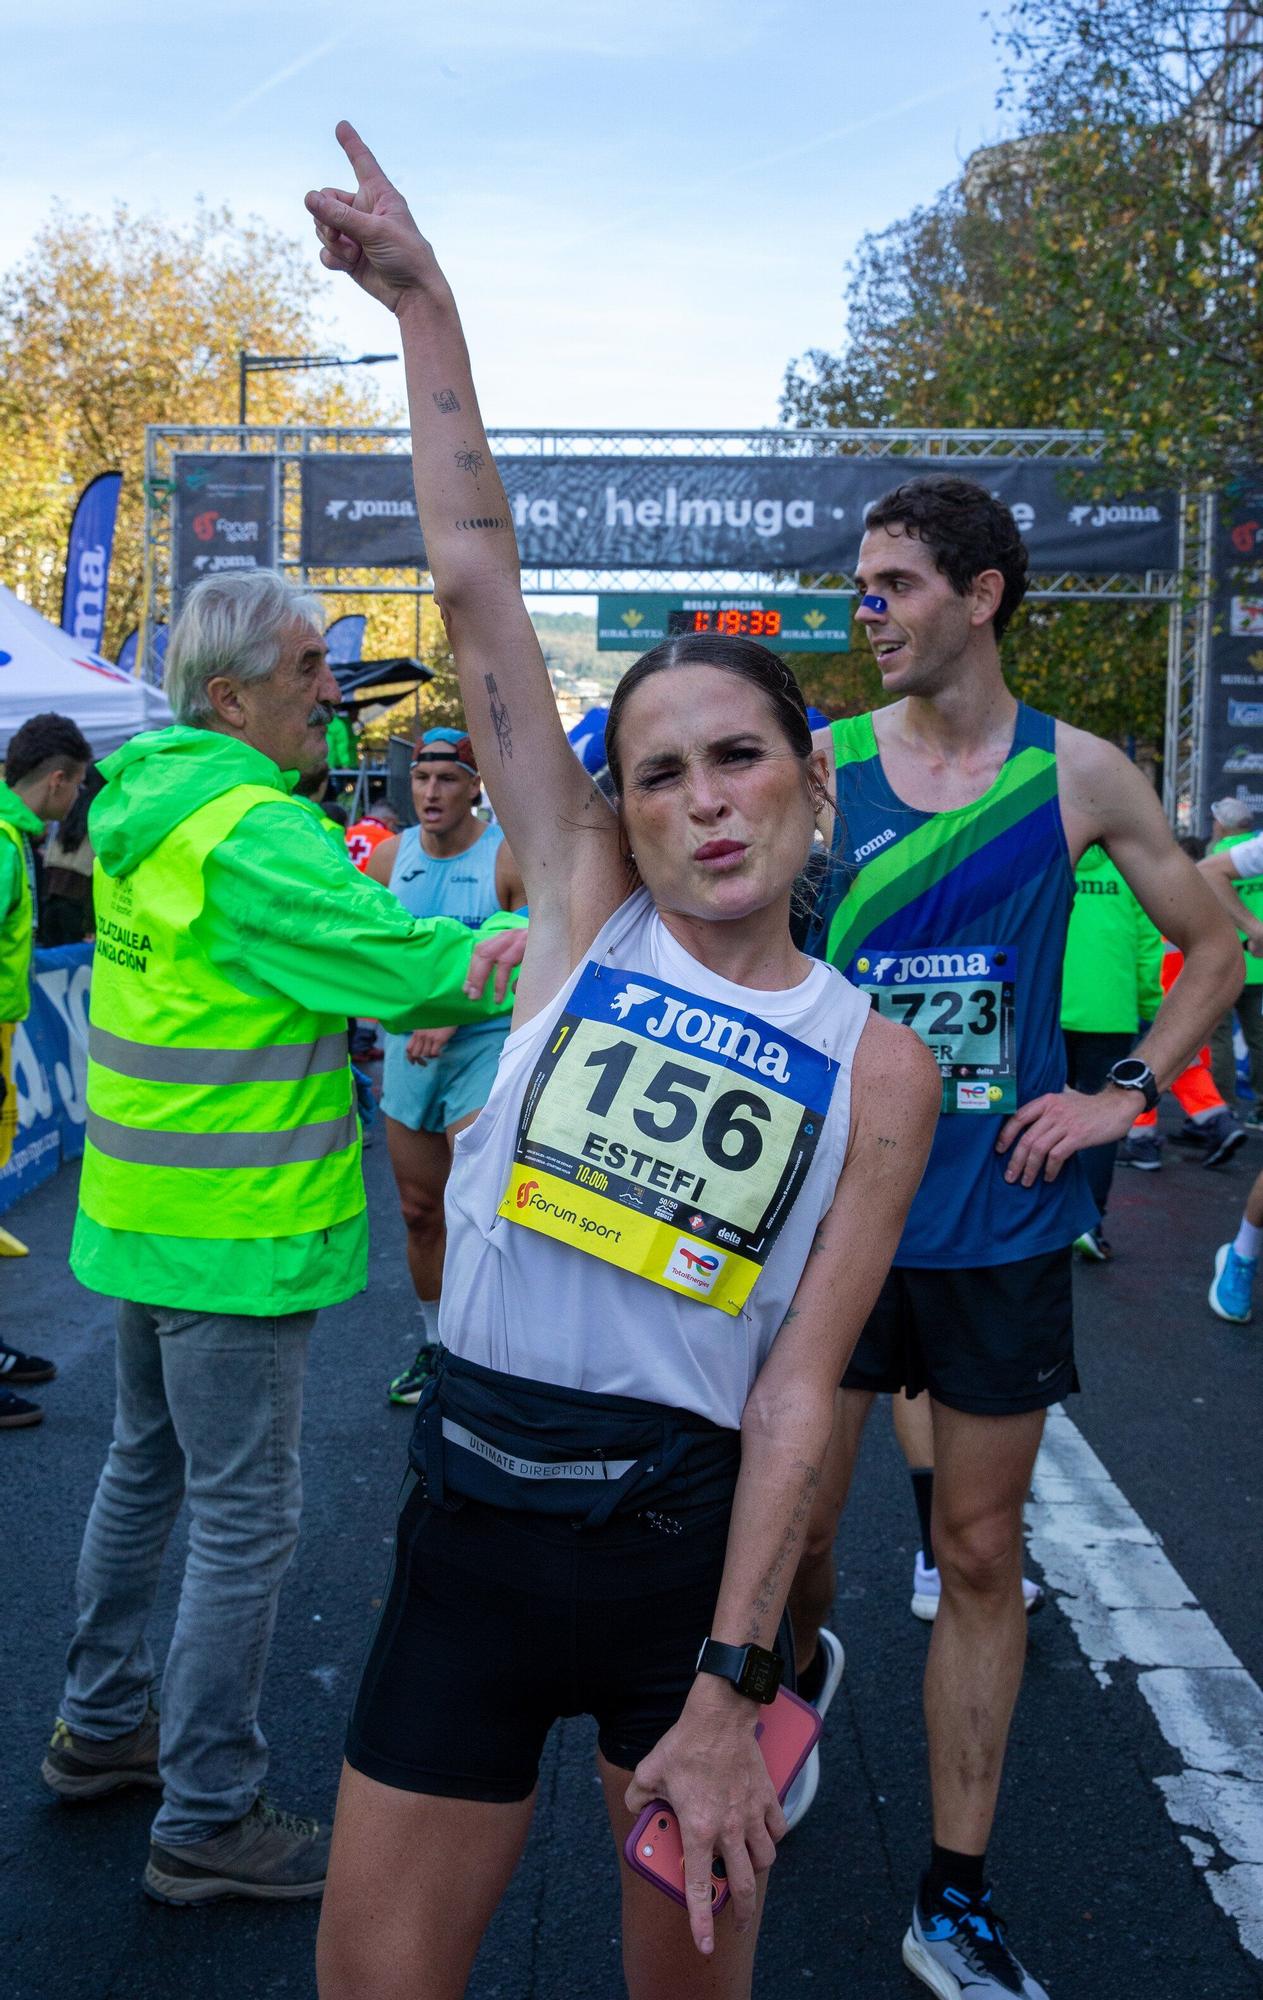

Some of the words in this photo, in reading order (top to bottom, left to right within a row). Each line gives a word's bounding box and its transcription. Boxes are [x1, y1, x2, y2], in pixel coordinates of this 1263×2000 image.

[348, 499, 416, 521] Joma
[514, 493, 558, 526] ta
[605, 486, 815, 537] helmuga
[1091, 504, 1161, 527] Joma
[74, 546, 105, 650] ma
[694, 610, 782, 635] 1:19:39
[853, 827, 897, 863] Joma
[1079, 880, 1120, 895] ma
[894, 953, 990, 983] Joma
[870, 989, 998, 1036] 723
[552, 1026, 570, 1054] 1
[645, 996, 792, 1084] Joma
[584, 1040, 772, 1172] 156
[576, 1164, 609, 1191] 10:00h
[581, 1132, 708, 1202] ESTEFI
[658, 1196, 678, 1210] 50/50
[580, 1218, 622, 1244] sport
[718, 1227, 741, 1245] delta
[469, 1436, 515, 1470] ULTIMATE
[519, 1462, 595, 1477] DIRECTION
